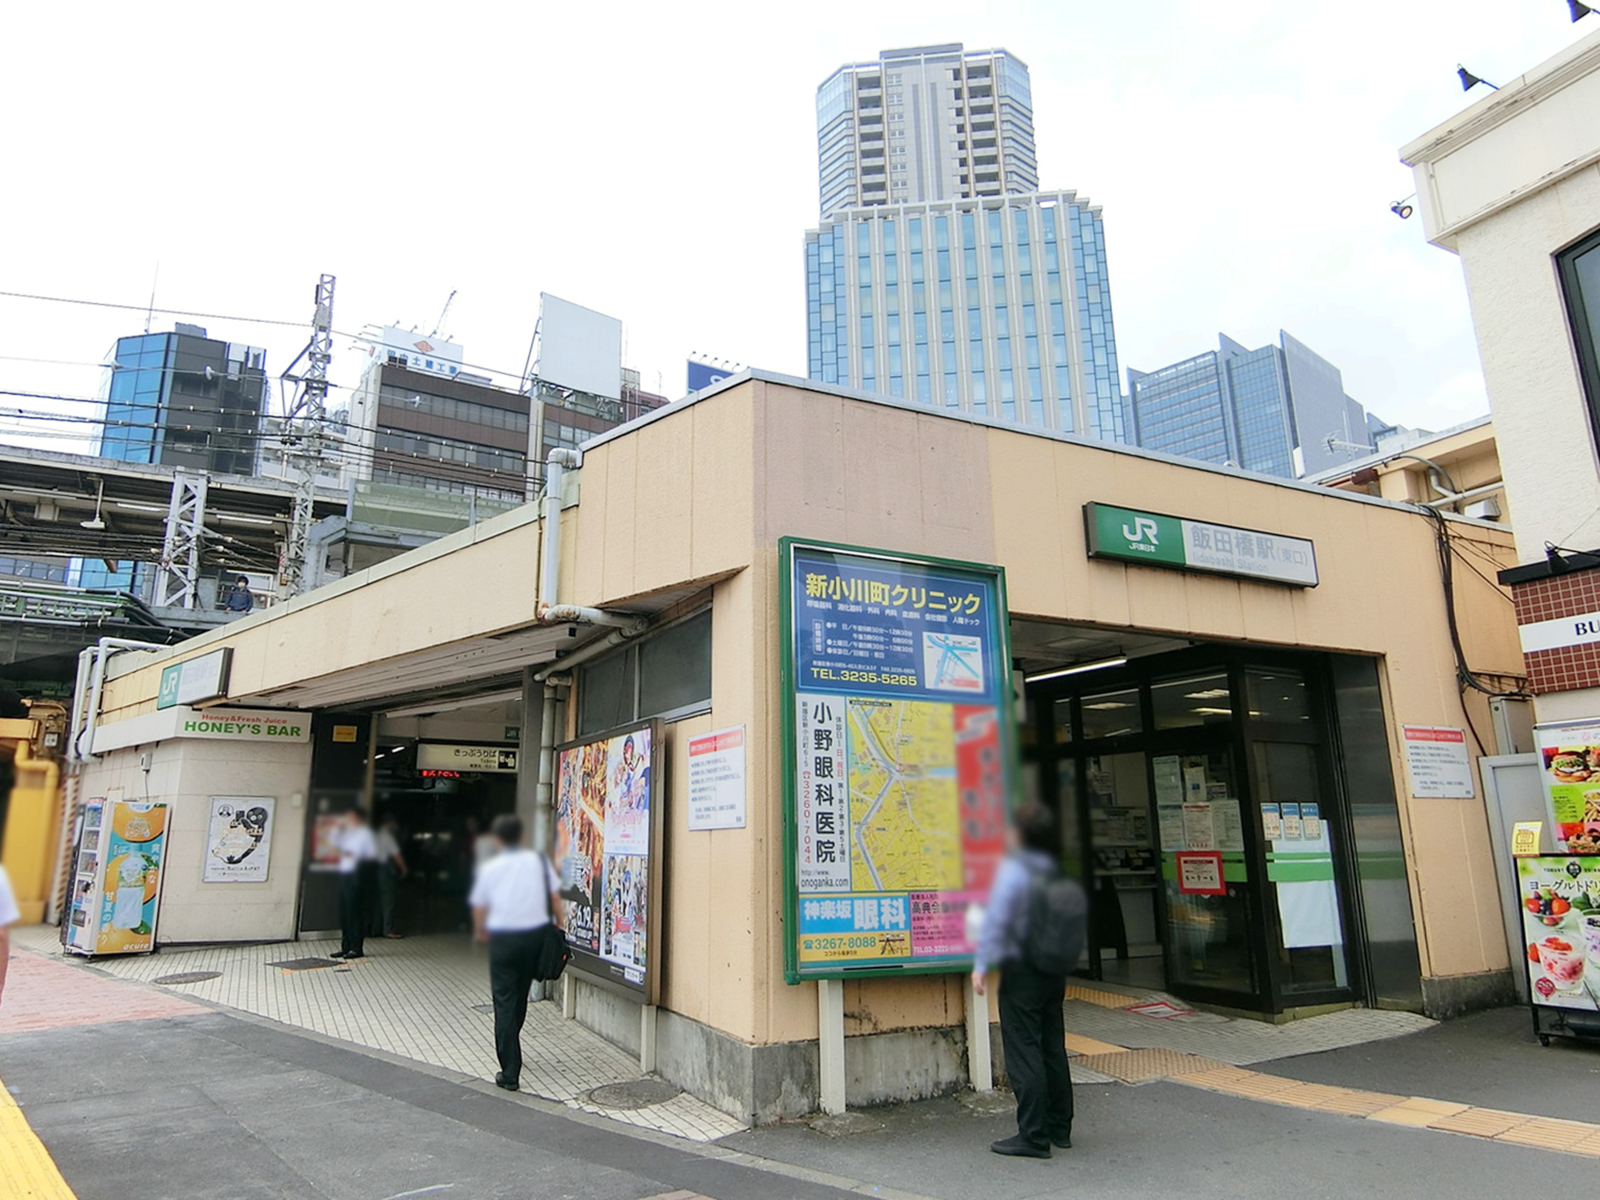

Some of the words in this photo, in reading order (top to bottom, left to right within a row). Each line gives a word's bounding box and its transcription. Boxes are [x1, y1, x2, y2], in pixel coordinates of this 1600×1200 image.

[1122, 517, 1159, 545] JR
[1237, 558, 1269, 574] Station
[805, 573, 982, 615] 新小川町クリニック
[163, 671, 178, 697] JR
[811, 667, 917, 686] TEL.3235-5265
[185, 721, 262, 735] HONEY'S
[267, 725, 302, 737] BAR
[264, 717, 288, 725] Juice
[454, 748, 498, 758] きっぷうりば
[813, 702, 836, 864] 小野眼科医院
[801, 876, 849, 890] onoganka.com
[122, 942, 150, 951] acure
[815, 937, 877, 950] 3267-8088
